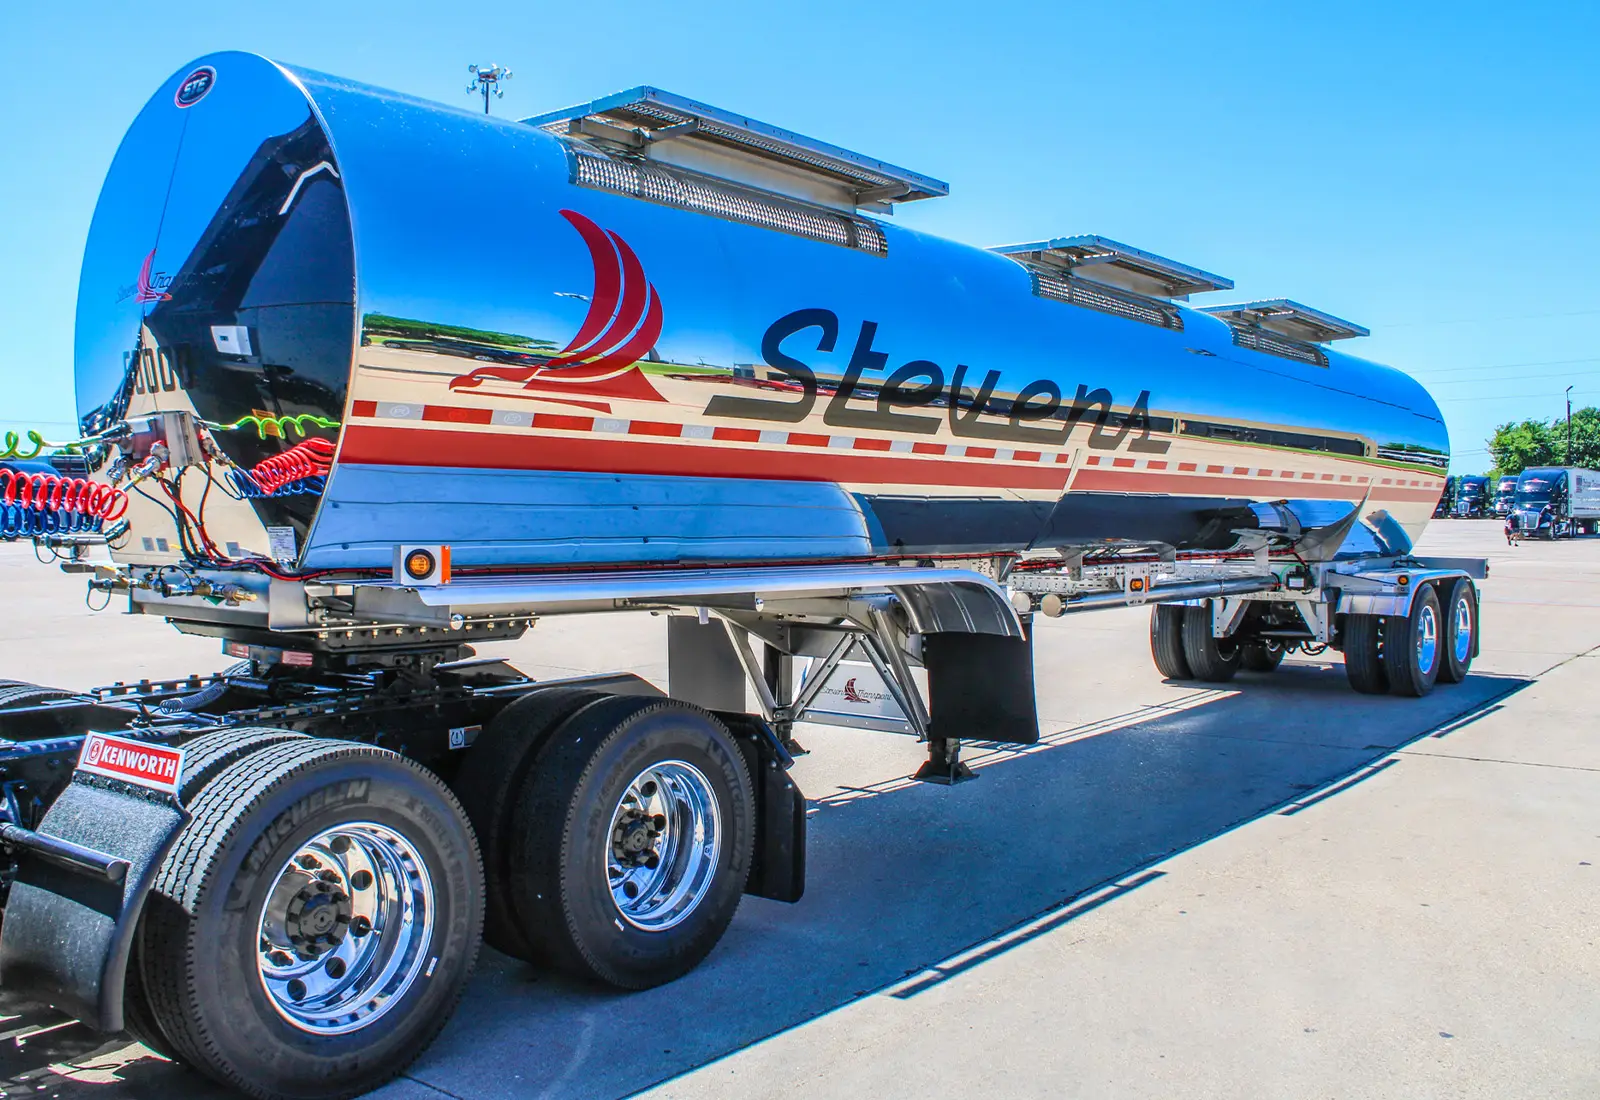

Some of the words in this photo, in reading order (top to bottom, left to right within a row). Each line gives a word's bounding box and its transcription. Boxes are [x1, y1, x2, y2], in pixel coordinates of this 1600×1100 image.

[702, 308, 1171, 454] Stevens
[101, 745, 177, 778] KENWORTH
[249, 779, 370, 873] MICHELIN
